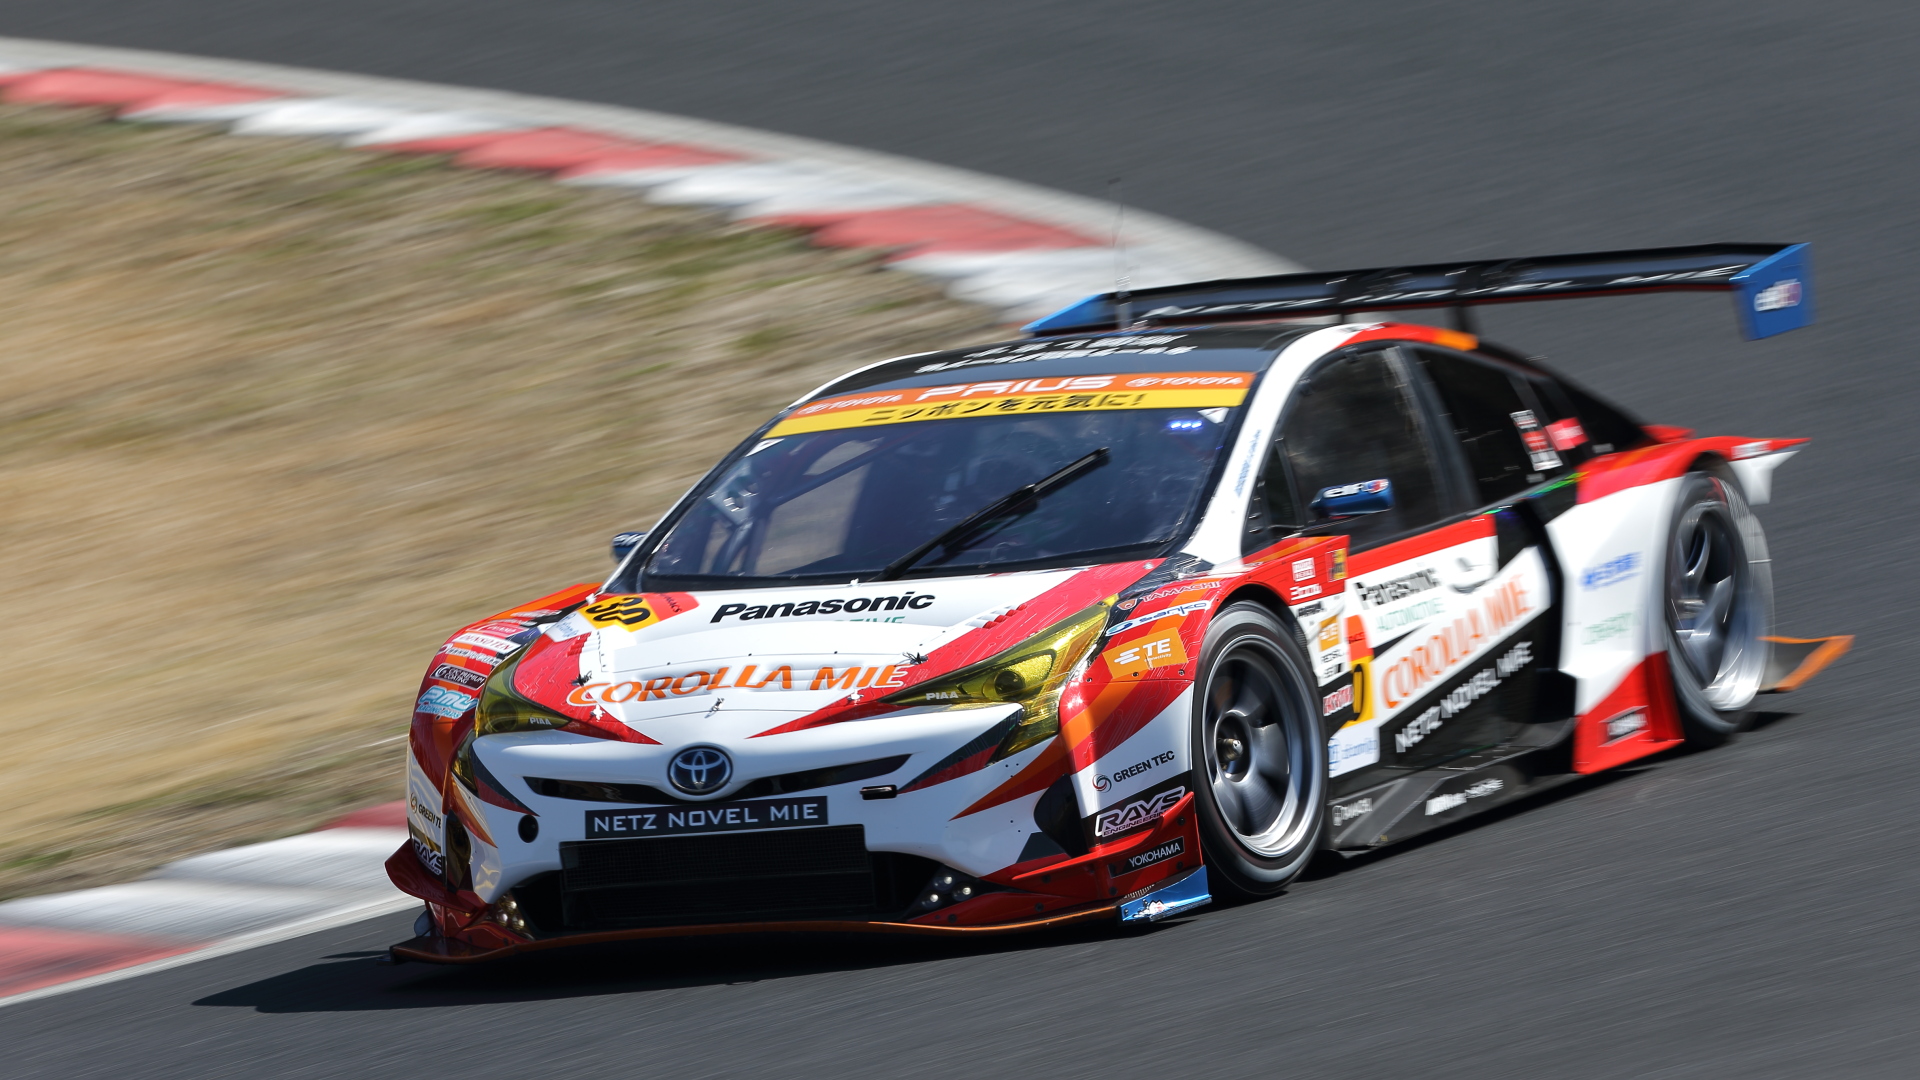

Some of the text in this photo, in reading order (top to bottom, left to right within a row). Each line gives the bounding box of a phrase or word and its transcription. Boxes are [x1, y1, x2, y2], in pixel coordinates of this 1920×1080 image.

[915, 376, 1117, 402] PRIUS
[1159, 376, 1244, 386] TOYOTA
[828, 394, 904, 409] TOYOTA
[1139, 581, 1222, 603] TAMACHI
[585, 596, 651, 626] 30
[709, 591, 936, 624] Panasonic
[1139, 601, 1208, 623] sanko
[1142, 637, 1171, 657] TE
[566, 663, 909, 706] COROLLA MIE
[926, 690, 959, 701] PIAA
[529, 716, 552, 726] PIAA
[1113, 750, 1176, 783] GREEN TEC
[418, 803, 436, 824] GREEN
[593, 803, 819, 833] NETZ NOVEL MIE
[1097, 788, 1186, 833] RAYS
[1128, 841, 1181, 868] YOKOHAMA
